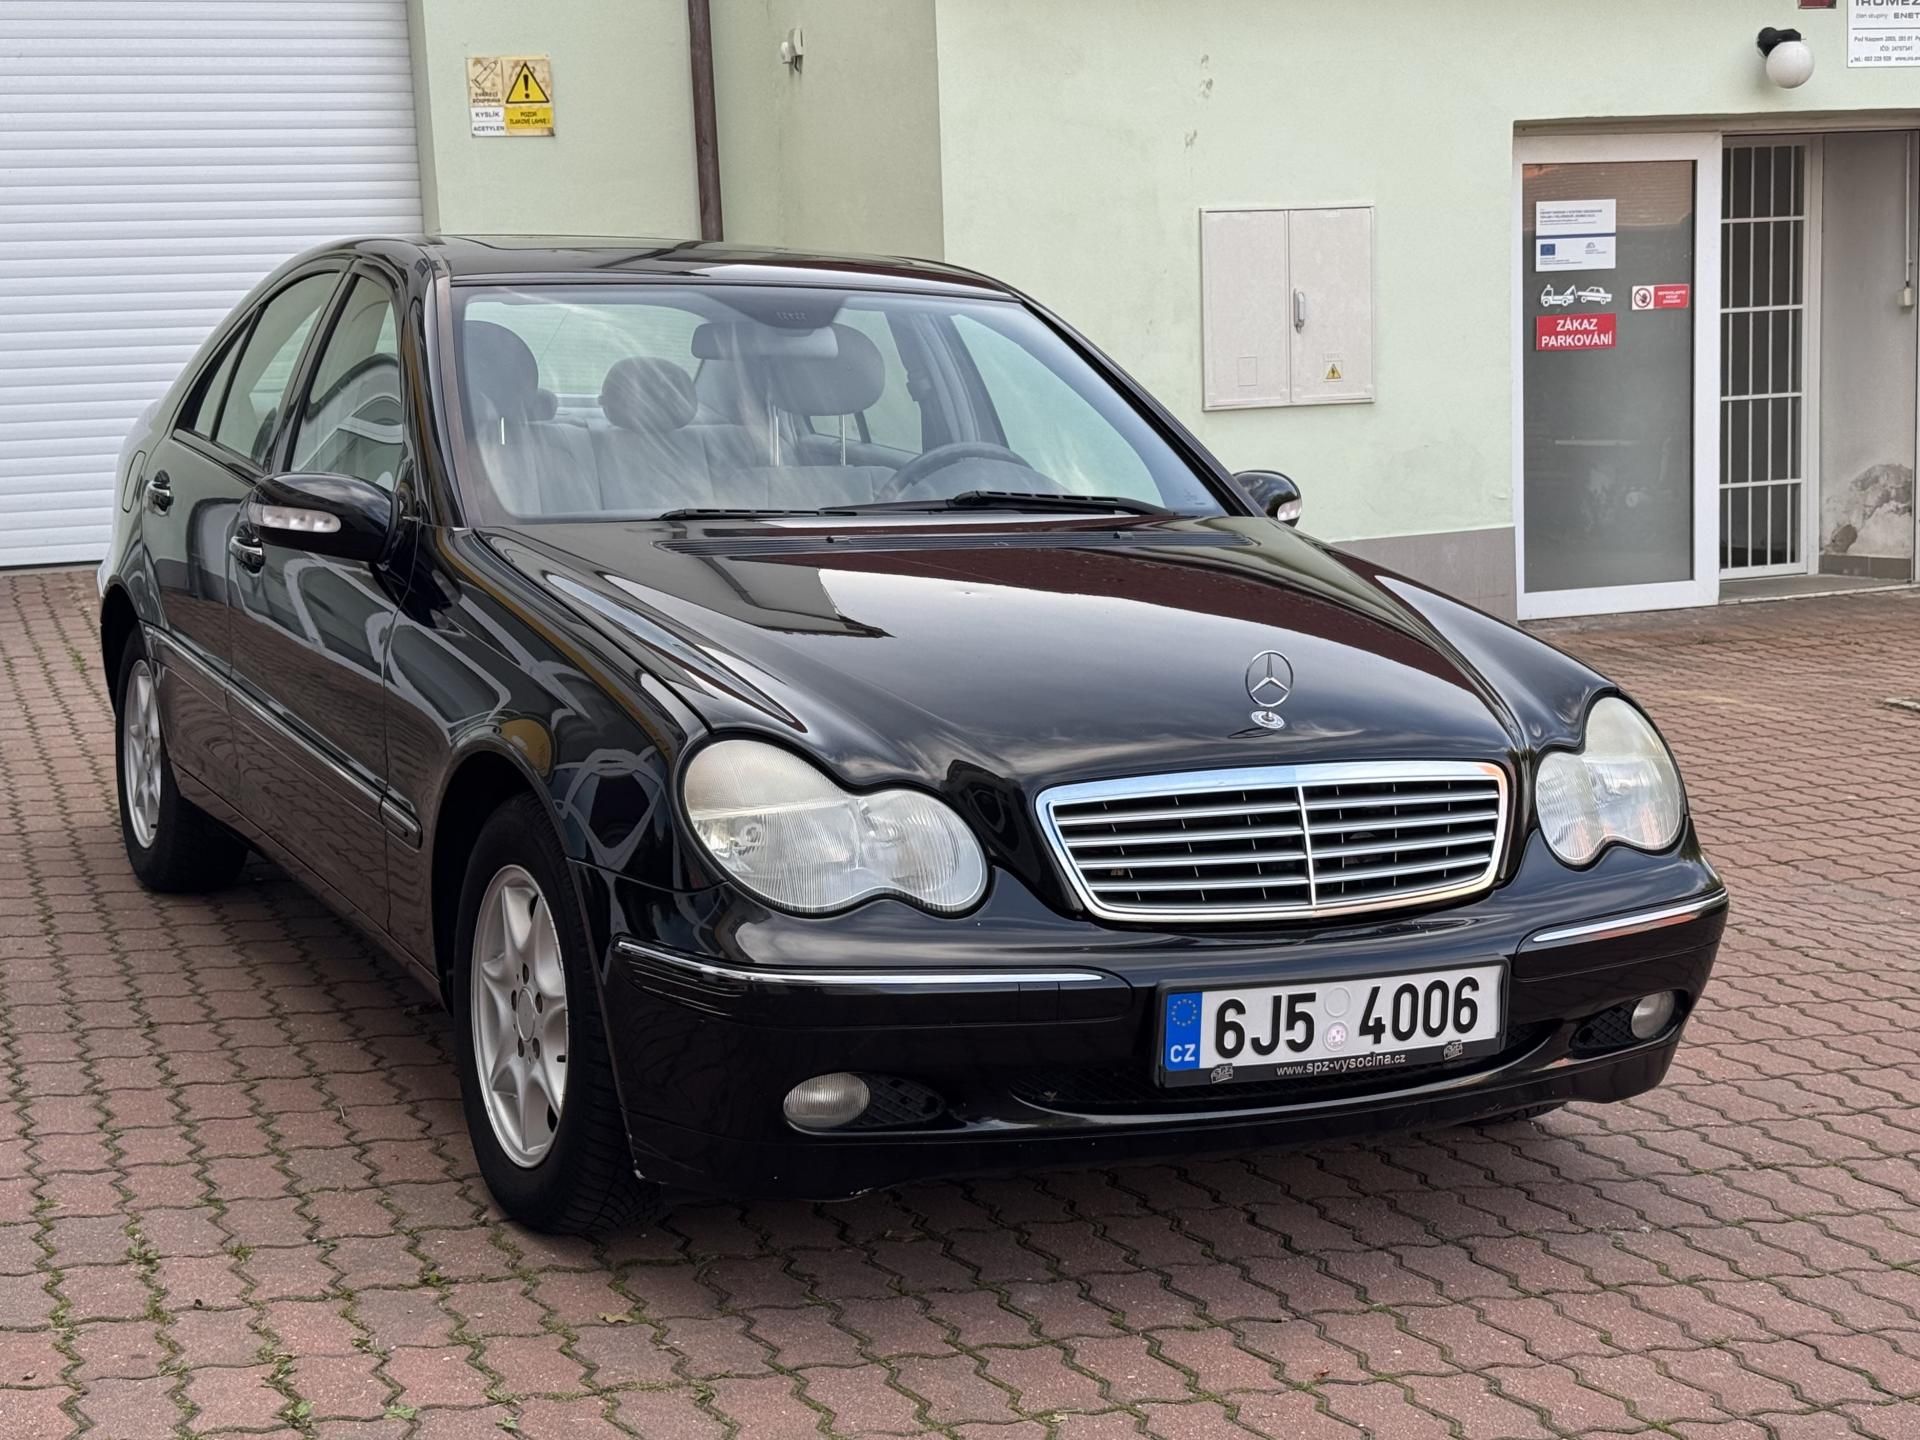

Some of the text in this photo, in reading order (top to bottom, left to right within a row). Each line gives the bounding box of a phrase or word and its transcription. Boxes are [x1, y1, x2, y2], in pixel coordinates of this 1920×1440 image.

[1556, 317, 1598, 331] ZÁKAZ
[1541, 331, 1612, 347] PARKOVÁNÍ
[1214, 976, 1480, 1060] 6J5 4006
[1170, 1044, 1196, 1063] CZ
[1276, 1053, 1406, 1076] www.spz-vysocina.cz
